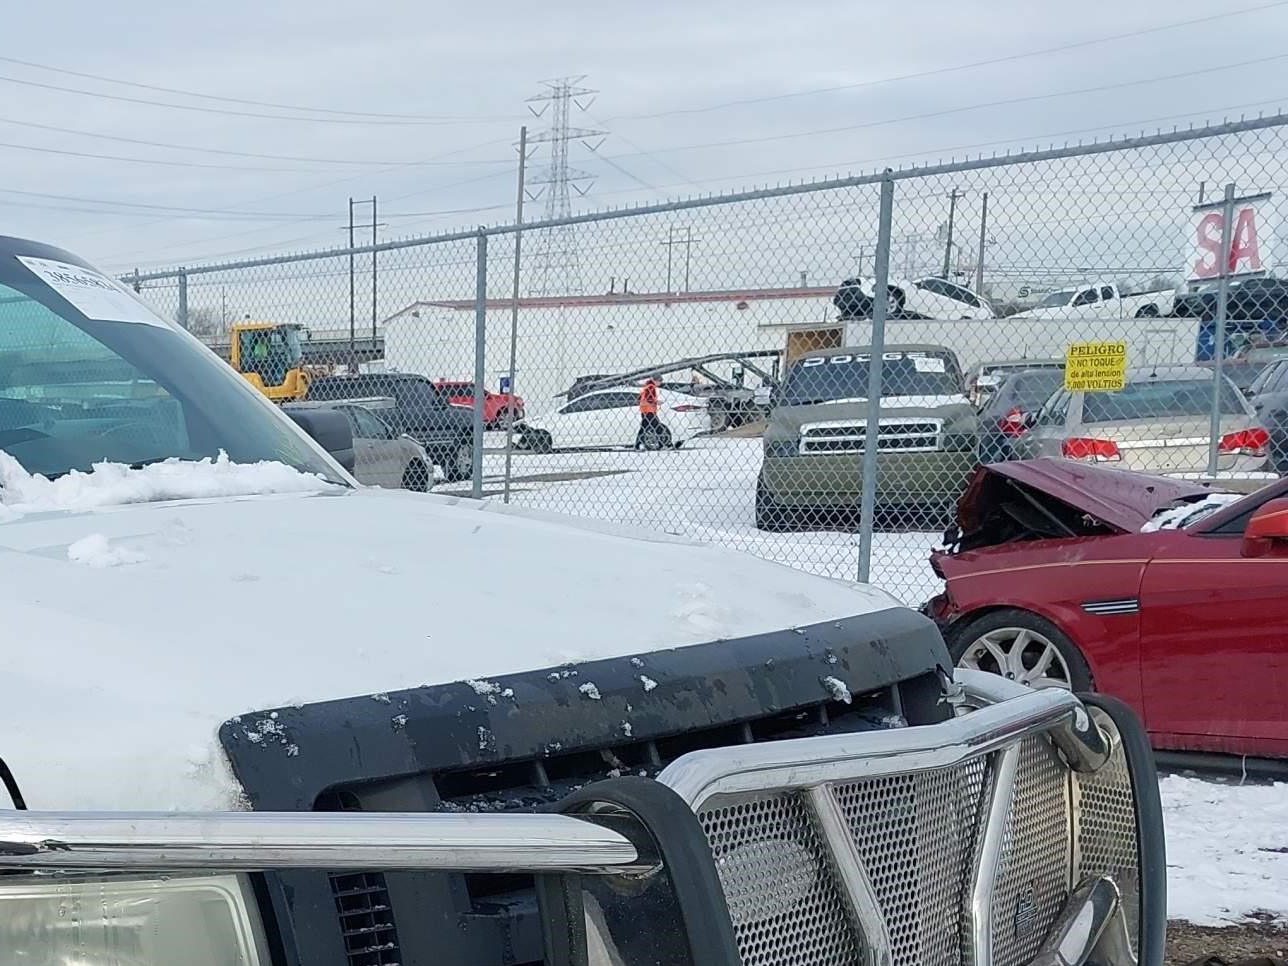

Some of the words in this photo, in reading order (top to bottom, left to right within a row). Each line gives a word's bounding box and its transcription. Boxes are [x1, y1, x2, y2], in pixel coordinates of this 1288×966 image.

[1071, 344, 1124, 355] PELIGRO
[803, 352, 926, 367] DODGE
[1076, 359, 1087, 367] NO
[1090, 357, 1115, 367] TOQUE
